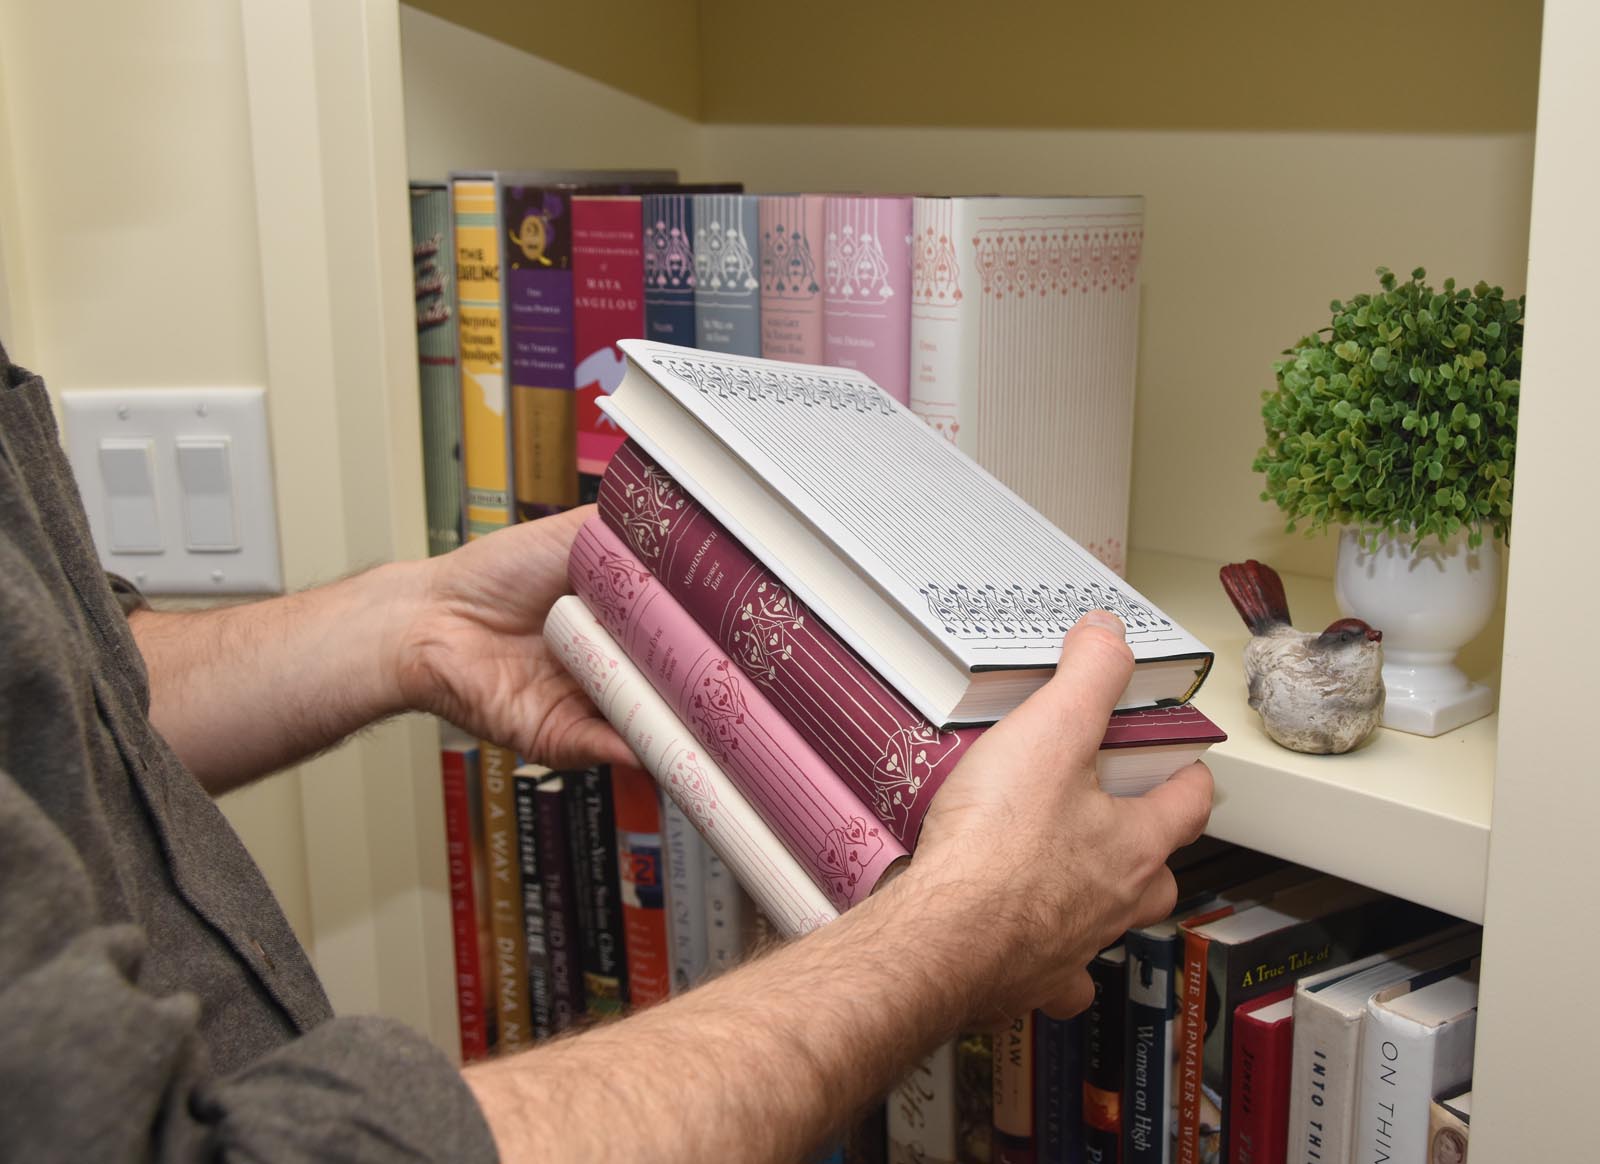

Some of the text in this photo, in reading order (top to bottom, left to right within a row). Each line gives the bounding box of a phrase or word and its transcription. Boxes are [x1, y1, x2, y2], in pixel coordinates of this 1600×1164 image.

[486, 747, 510, 883] IND A WAY
[497, 936, 517, 1012] DIANA
[1189, 961, 1202, 997] THE
[1241, 970, 1254, 988] A
[1256, 963, 1286, 983] True
[1288, 950, 1314, 971] Tale
[1009, 1017, 1025, 1067] RAW
[1183, 1002, 1200, 1117] MAPMAKER'S
[1379, 1041, 1399, 1086] ON
[1130, 1025, 1154, 1151] Women on High
[1306, 1050, 1328, 1164] INTO THI
